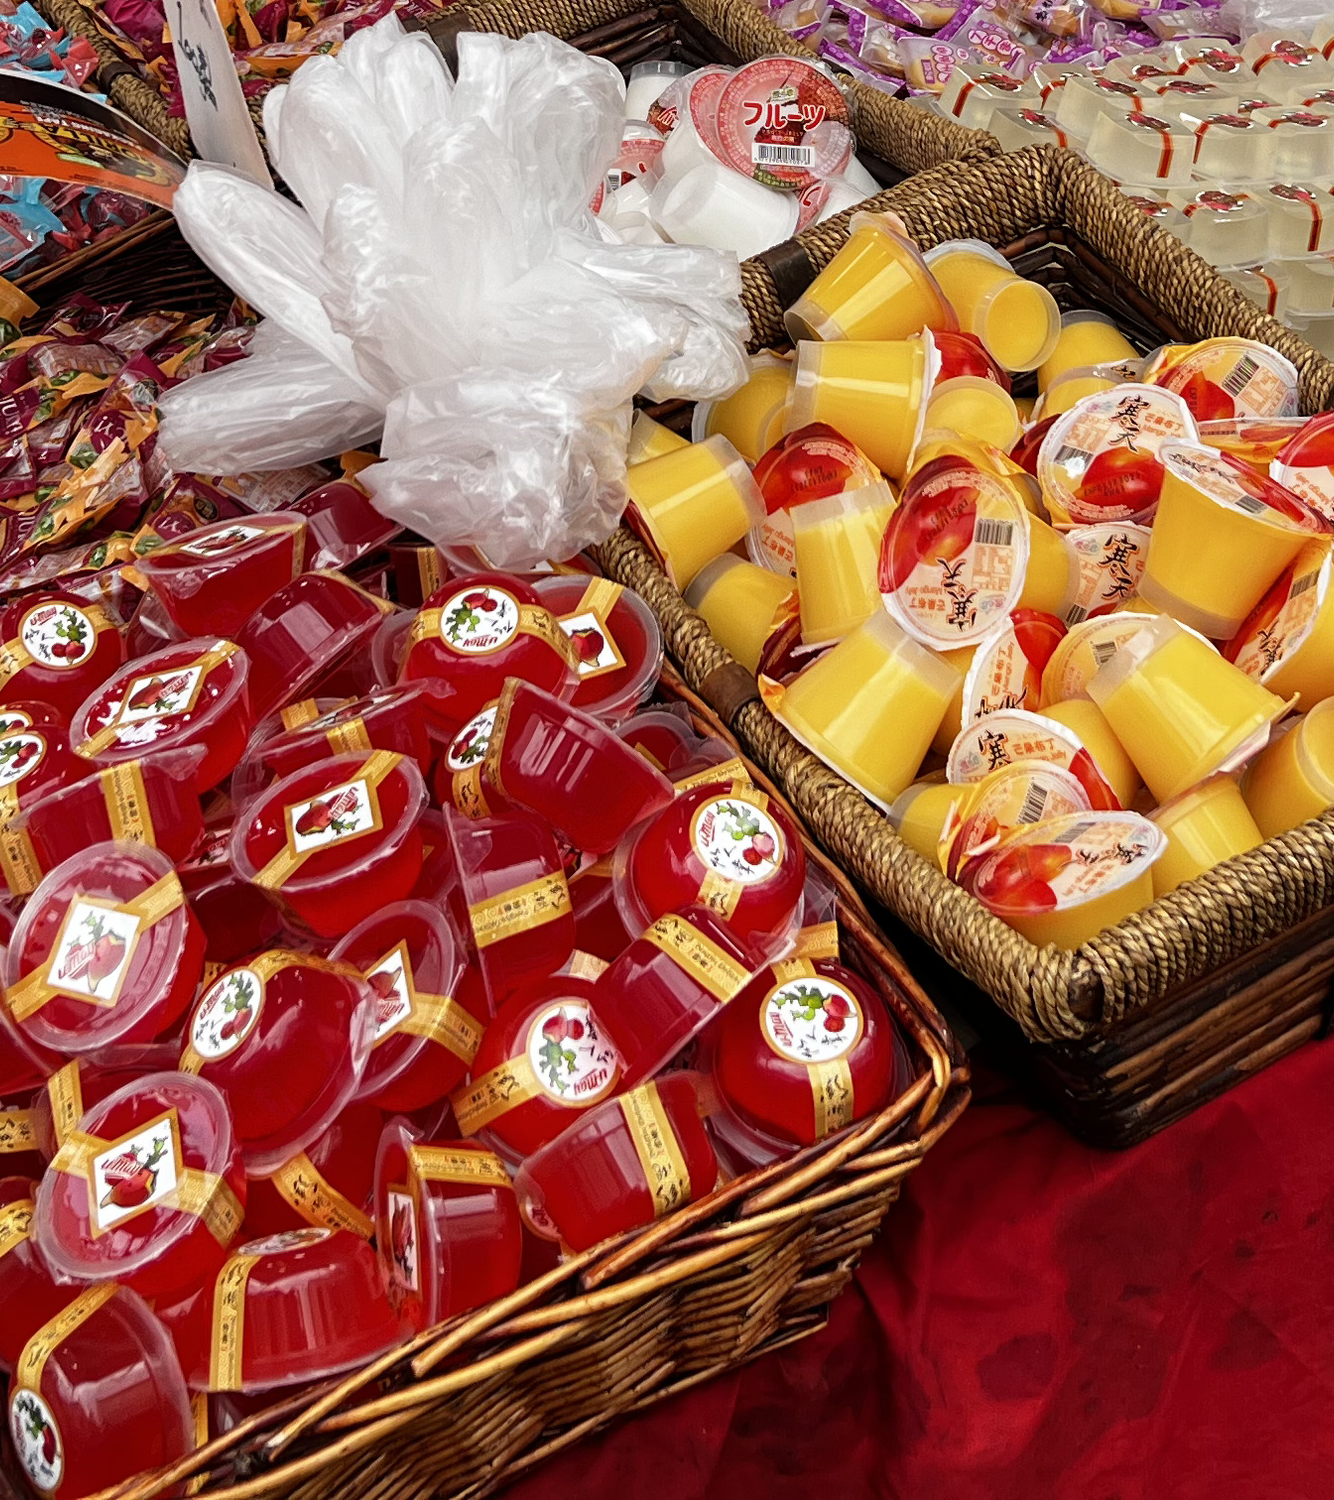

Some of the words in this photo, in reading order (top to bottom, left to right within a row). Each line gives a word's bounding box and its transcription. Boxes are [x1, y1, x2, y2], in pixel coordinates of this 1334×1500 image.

[743, 102, 826, 132] フルーツ
[1110, 395, 1151, 453] 寒天
[936, 557, 979, 631] 寒天
[1098, 534, 1138, 600] 寒天
